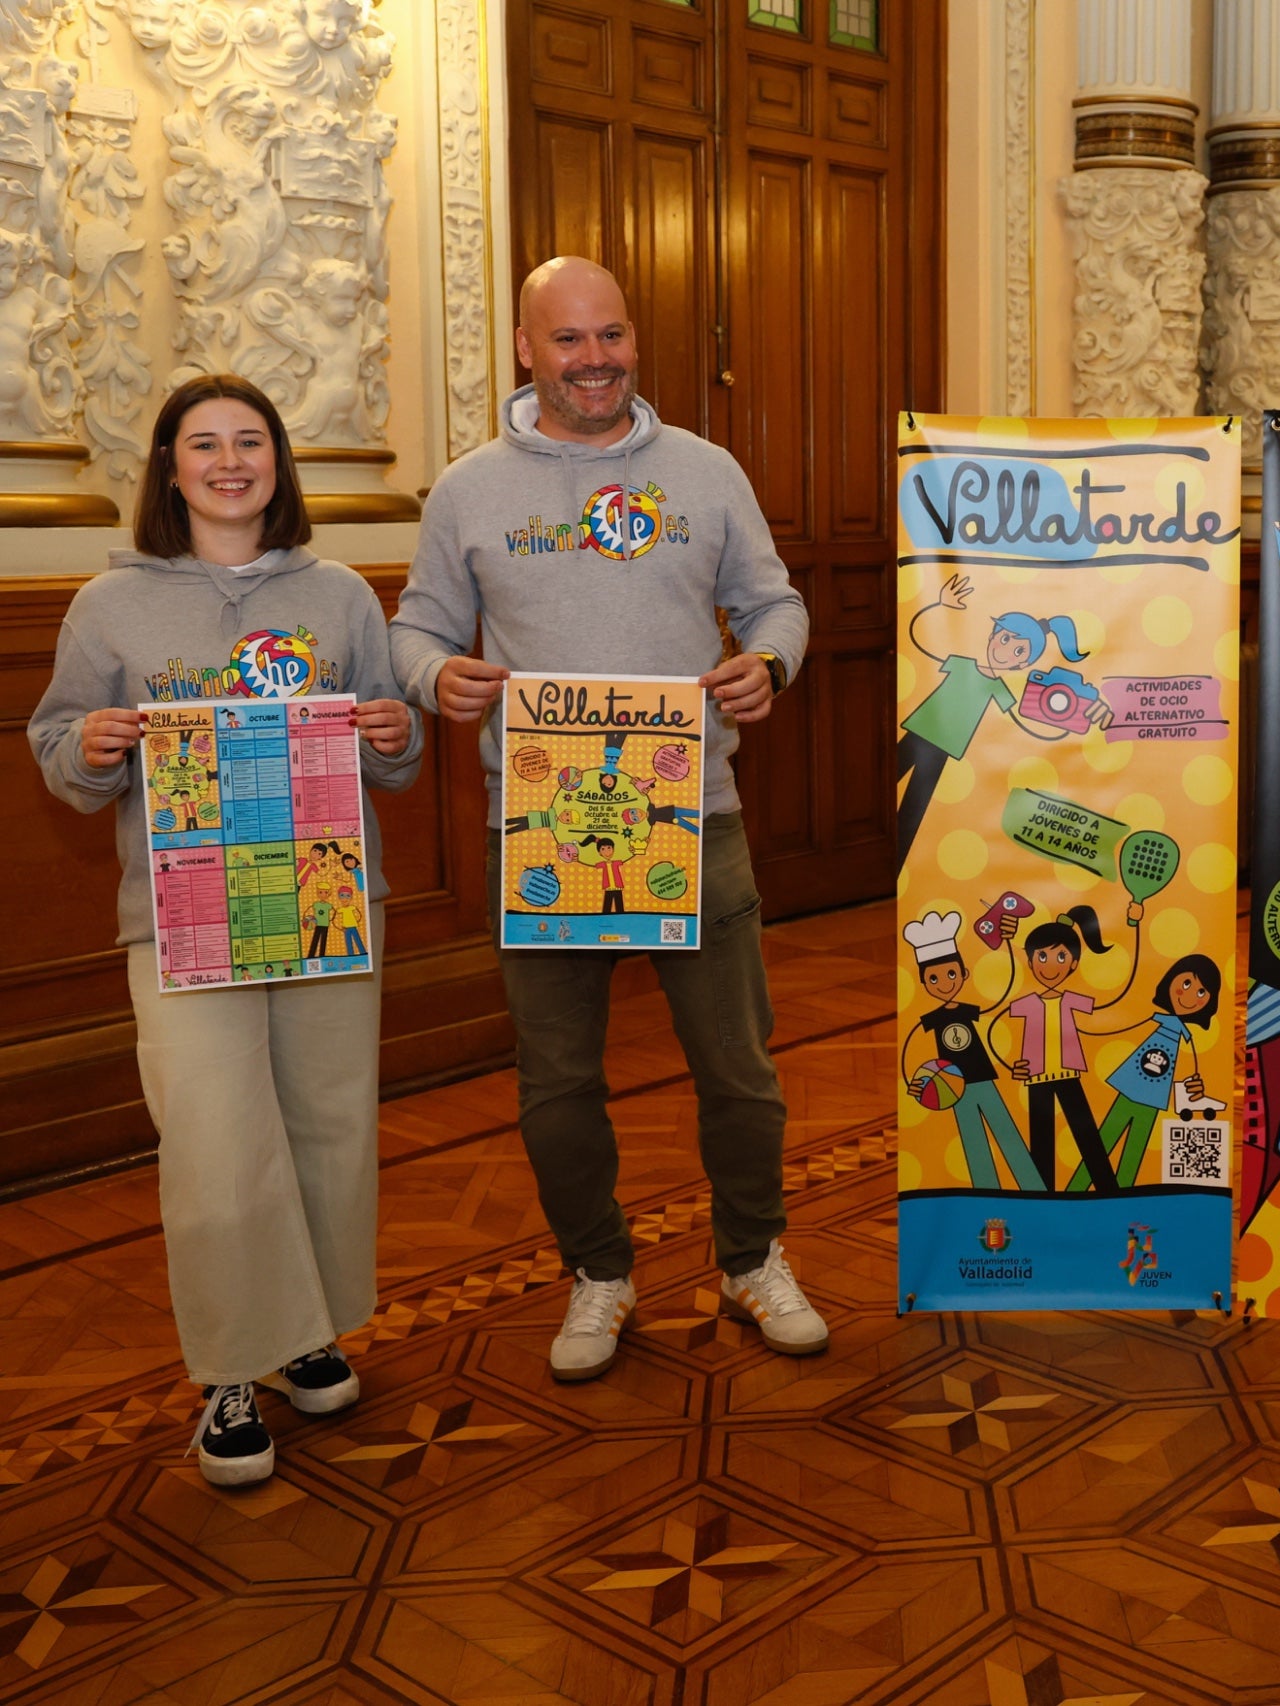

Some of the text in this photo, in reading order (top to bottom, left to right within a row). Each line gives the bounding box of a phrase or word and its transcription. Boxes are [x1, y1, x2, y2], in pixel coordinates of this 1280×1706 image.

[912, 461, 1241, 545] Vallatarde
[1126, 680, 1202, 693] ACTIVIDADES
[518, 681, 695, 726] Vallatarde
[1140, 695, 1188, 706] DE OCIO
[248, 714, 280, 722] OCTUBRE
[1125, 709, 1205, 721] ALTERNATIVO
[1138, 727, 1197, 739] GRATUITO
[576, 790, 629, 801] SÁBADOS
[1037, 800, 1100, 830] DIRIGIDO A
[1028, 813, 1100, 845] JÓVENES DE
[1021, 826, 1099, 860] 11 A 14 AÑOS
[176, 857, 217, 866] NOVIEMBRE
[254, 852, 289, 861] DICIEMBRE
[958, 1257, 1033, 1266] Ayuntamiento de
[958, 1266, 1033, 1279] Valladolid
[1141, 1271, 1172, 1280] JUVEN
[1139, 1279, 1159, 1288] TUD
